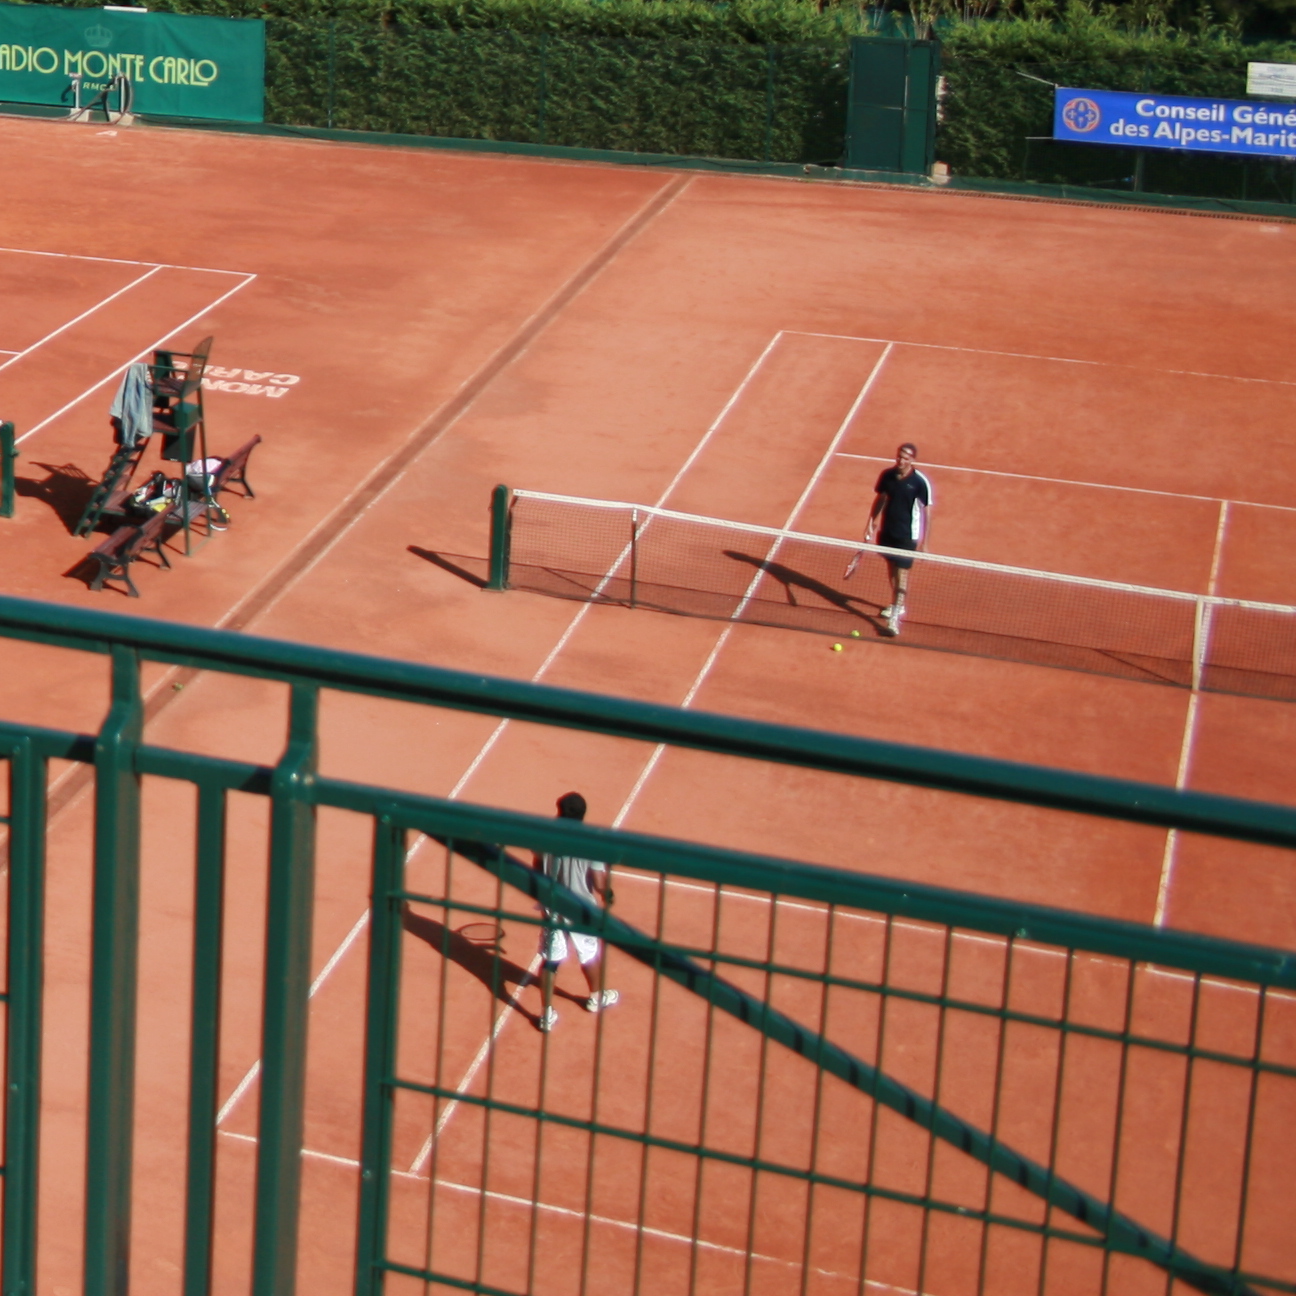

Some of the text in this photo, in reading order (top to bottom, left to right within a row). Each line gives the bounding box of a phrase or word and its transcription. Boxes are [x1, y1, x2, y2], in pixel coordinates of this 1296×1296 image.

[63, 48, 145, 83] MONTE
[148, 55, 219, 87] CARLO
[1135, 98, 1226, 122] Conseil
[1109, 118, 1150, 138] des
